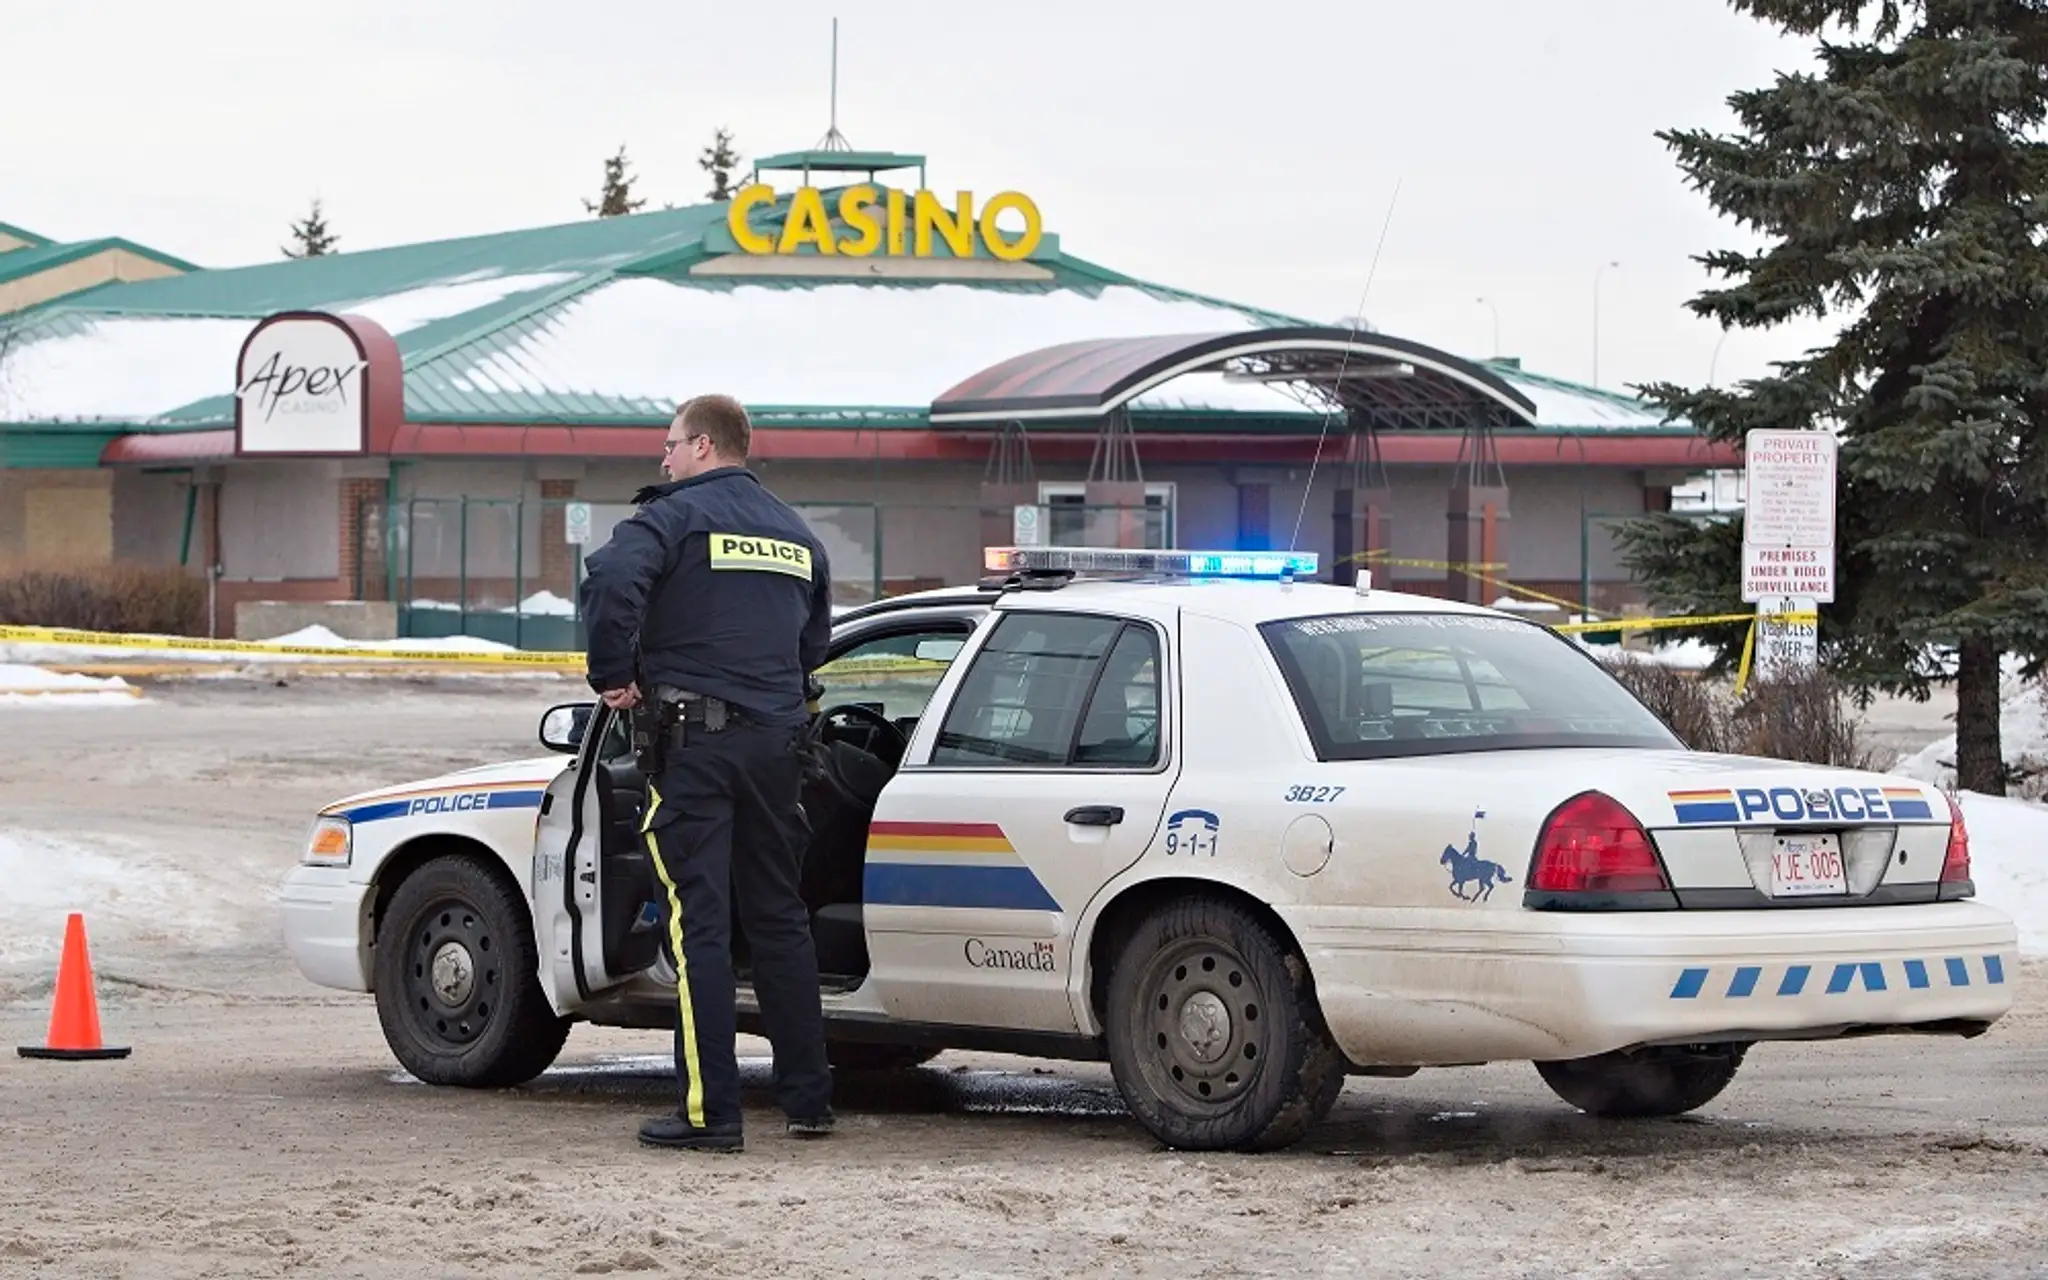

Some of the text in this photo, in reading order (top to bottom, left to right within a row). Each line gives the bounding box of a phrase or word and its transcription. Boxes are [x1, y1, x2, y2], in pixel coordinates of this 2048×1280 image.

[728, 184, 1043, 262] CASINO
[242, 351, 357, 424] Apex
[279, 400, 340, 414] CASINO
[1763, 439, 1820, 452] PRIVATE
[1753, 452, 1830, 464] PROPERTY
[722, 538, 805, 565] POLICE
[1759, 551, 1817, 562] PREMISES
[1751, 566, 1826, 577] UNDER VIDEO
[1747, 581, 1829, 593] SURVEILLANCE
[1780, 601, 1796, 613] NO
[1762, 619, 1814, 637] VECLES
[1772, 641, 1802, 657] OVER
[1284, 785, 1345, 802] 3B27
[410, 793, 488, 816] POLICE
[1736, 787, 1889, 820] POLICE
[1166, 833, 1218, 857] 9-1-1
[964, 938, 1056, 972] Canada
